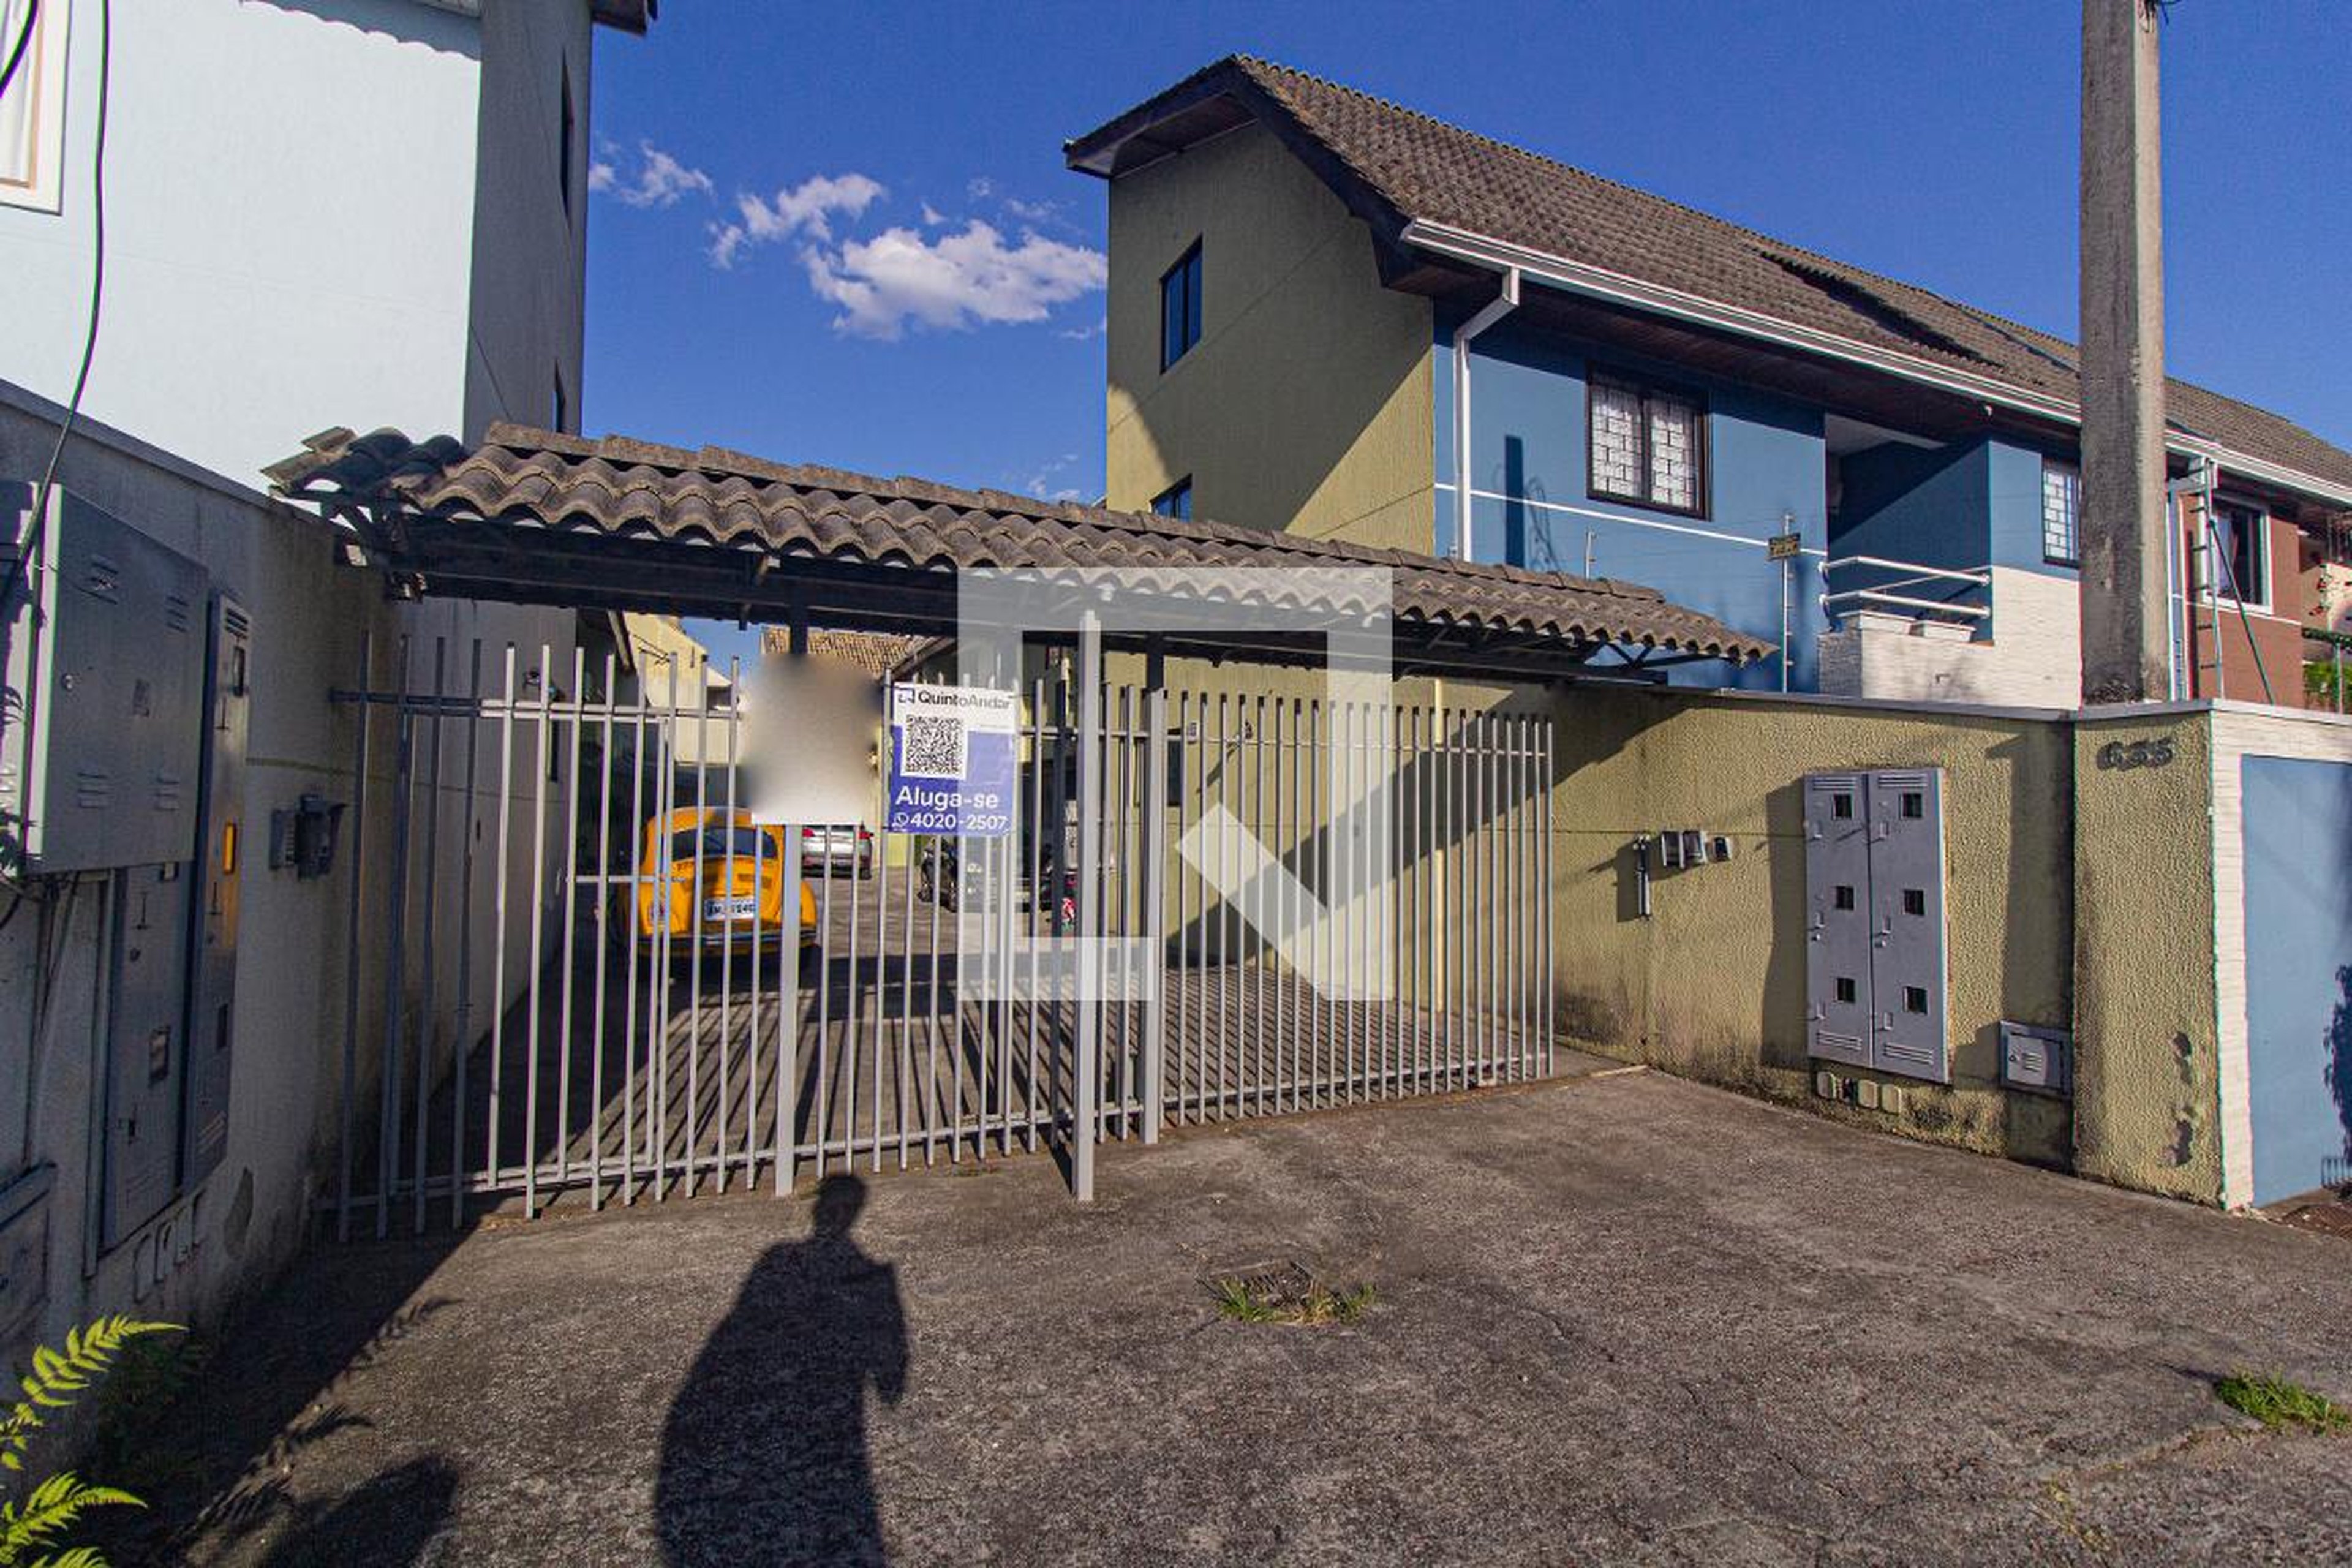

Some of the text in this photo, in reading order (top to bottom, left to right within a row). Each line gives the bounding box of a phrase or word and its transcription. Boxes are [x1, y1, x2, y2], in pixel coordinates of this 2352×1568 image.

[918, 690, 1010, 709] QuintoAndar
[895, 786, 999, 812] Aluga-se
[910, 812, 1008, 830] 4020-2507
